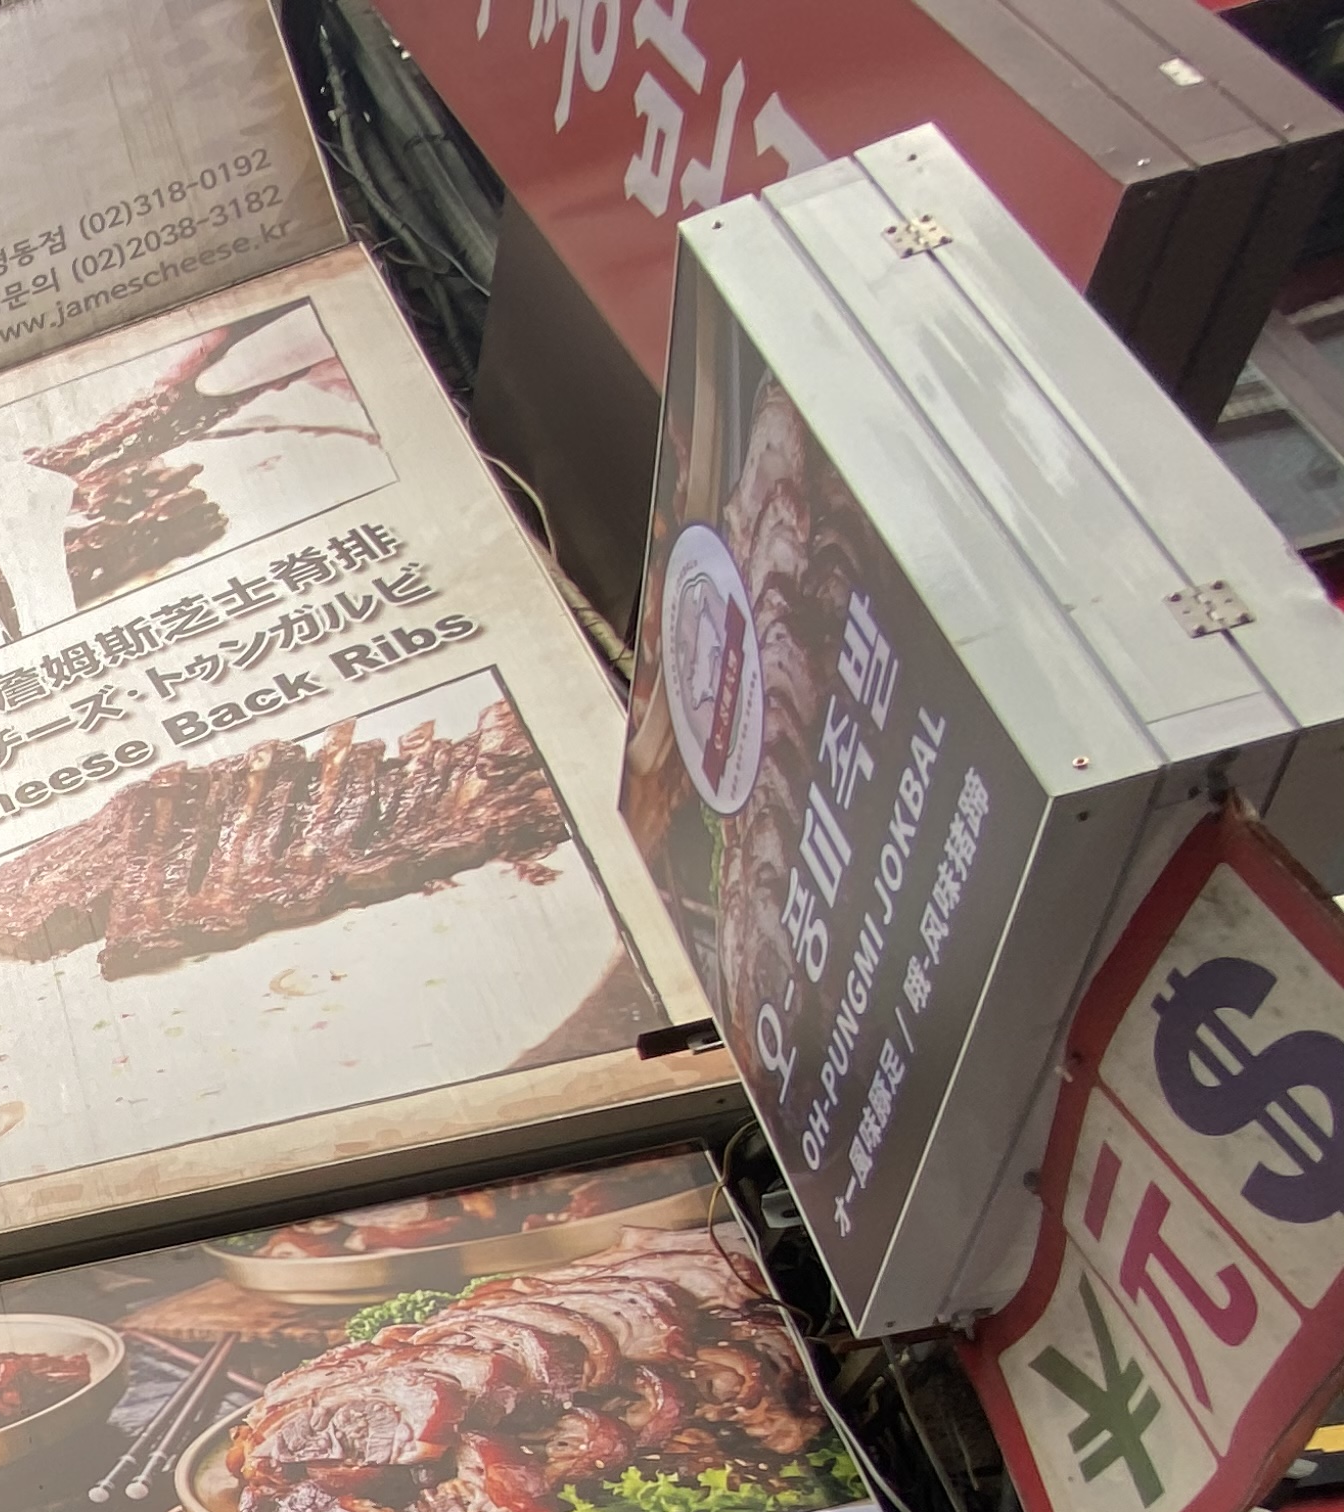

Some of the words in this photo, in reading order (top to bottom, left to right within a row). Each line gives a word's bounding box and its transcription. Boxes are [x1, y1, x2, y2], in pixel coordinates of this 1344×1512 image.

[71, 184, 283, 284] (02)2038-3182
[79, 148, 272, 241] (02)318-0192
[165, 670, 322, 747] Back
[337, 612, 485, 680] Ribs
[802, 912, 884, 1171] OH-PUNGMI
[874, 708, 947, 926] JOKBAL
[1083, 1139, 1260, 1414] 元
[1027, 1269, 1166, 1510] ¥
